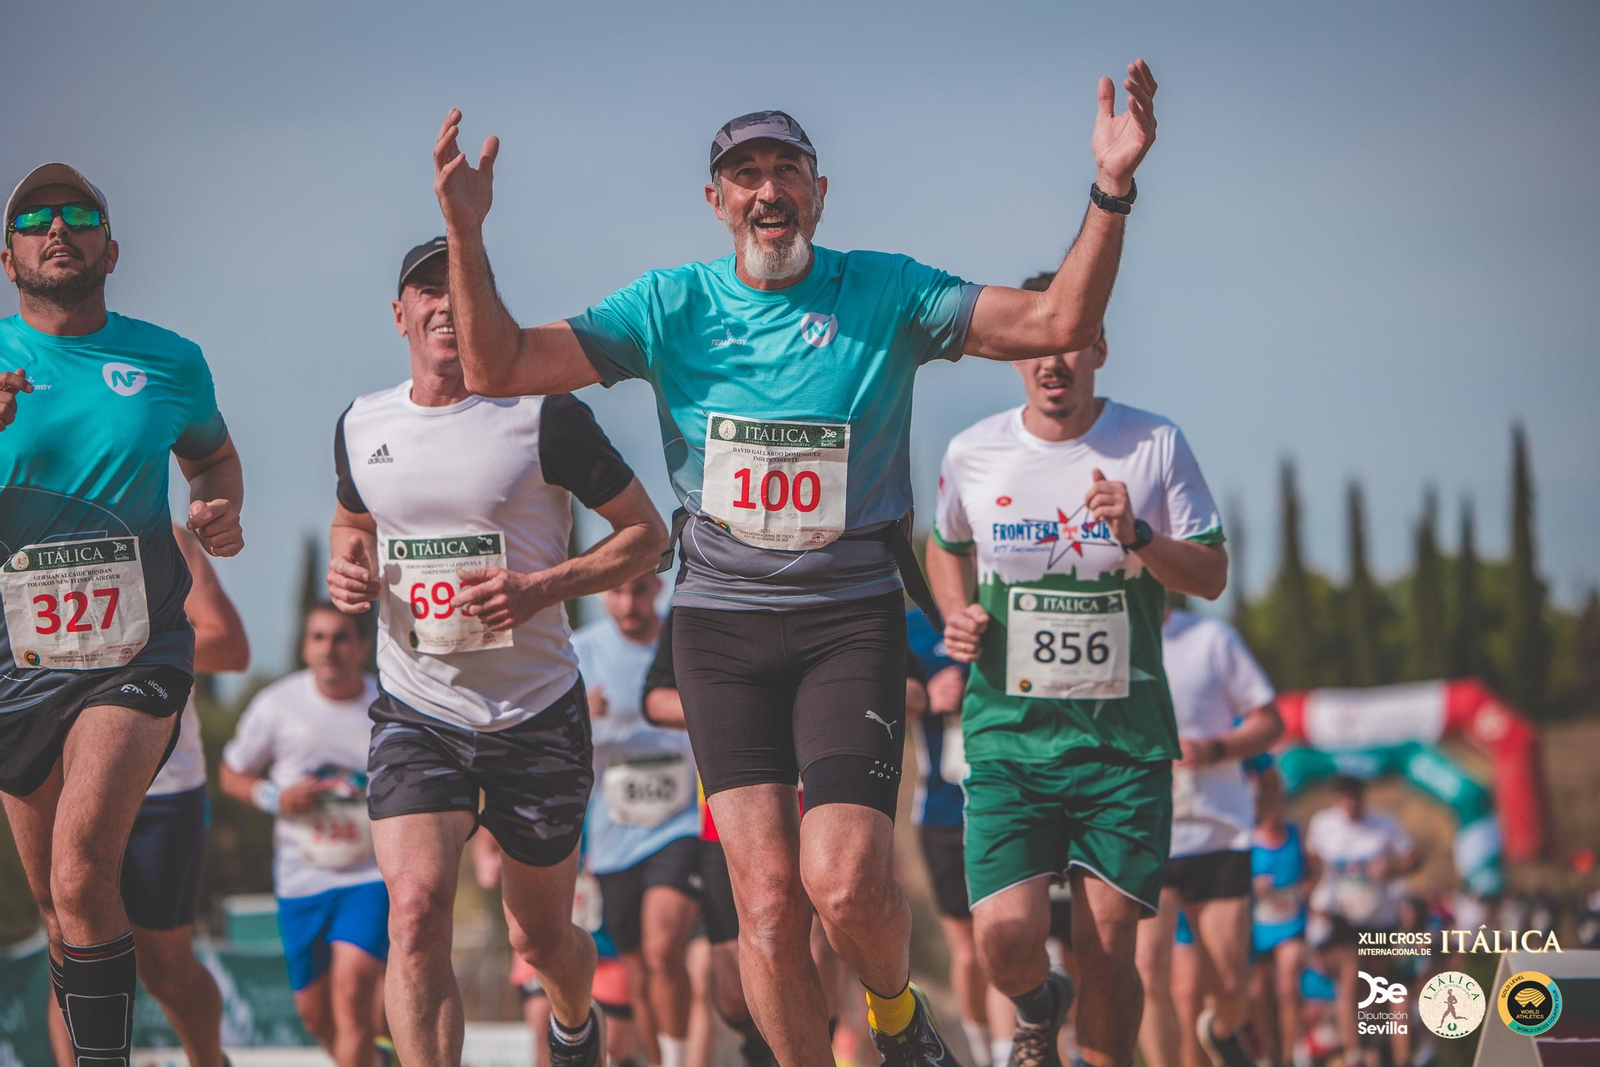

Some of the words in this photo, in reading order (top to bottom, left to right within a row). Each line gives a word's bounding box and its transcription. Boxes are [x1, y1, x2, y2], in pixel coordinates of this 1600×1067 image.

[745, 425, 810, 443] ITÁLICA
[368, 457, 394, 465] adidas
[751, 449, 784, 457] GALLARDO
[733, 468, 821, 513] 100
[38, 547, 104, 565] ITÁLICA
[412, 540, 469, 556] ITÁLICA
[410, 582, 481, 620] 69
[33, 587, 120, 635] 327
[1034, 630, 1109, 665] 856
